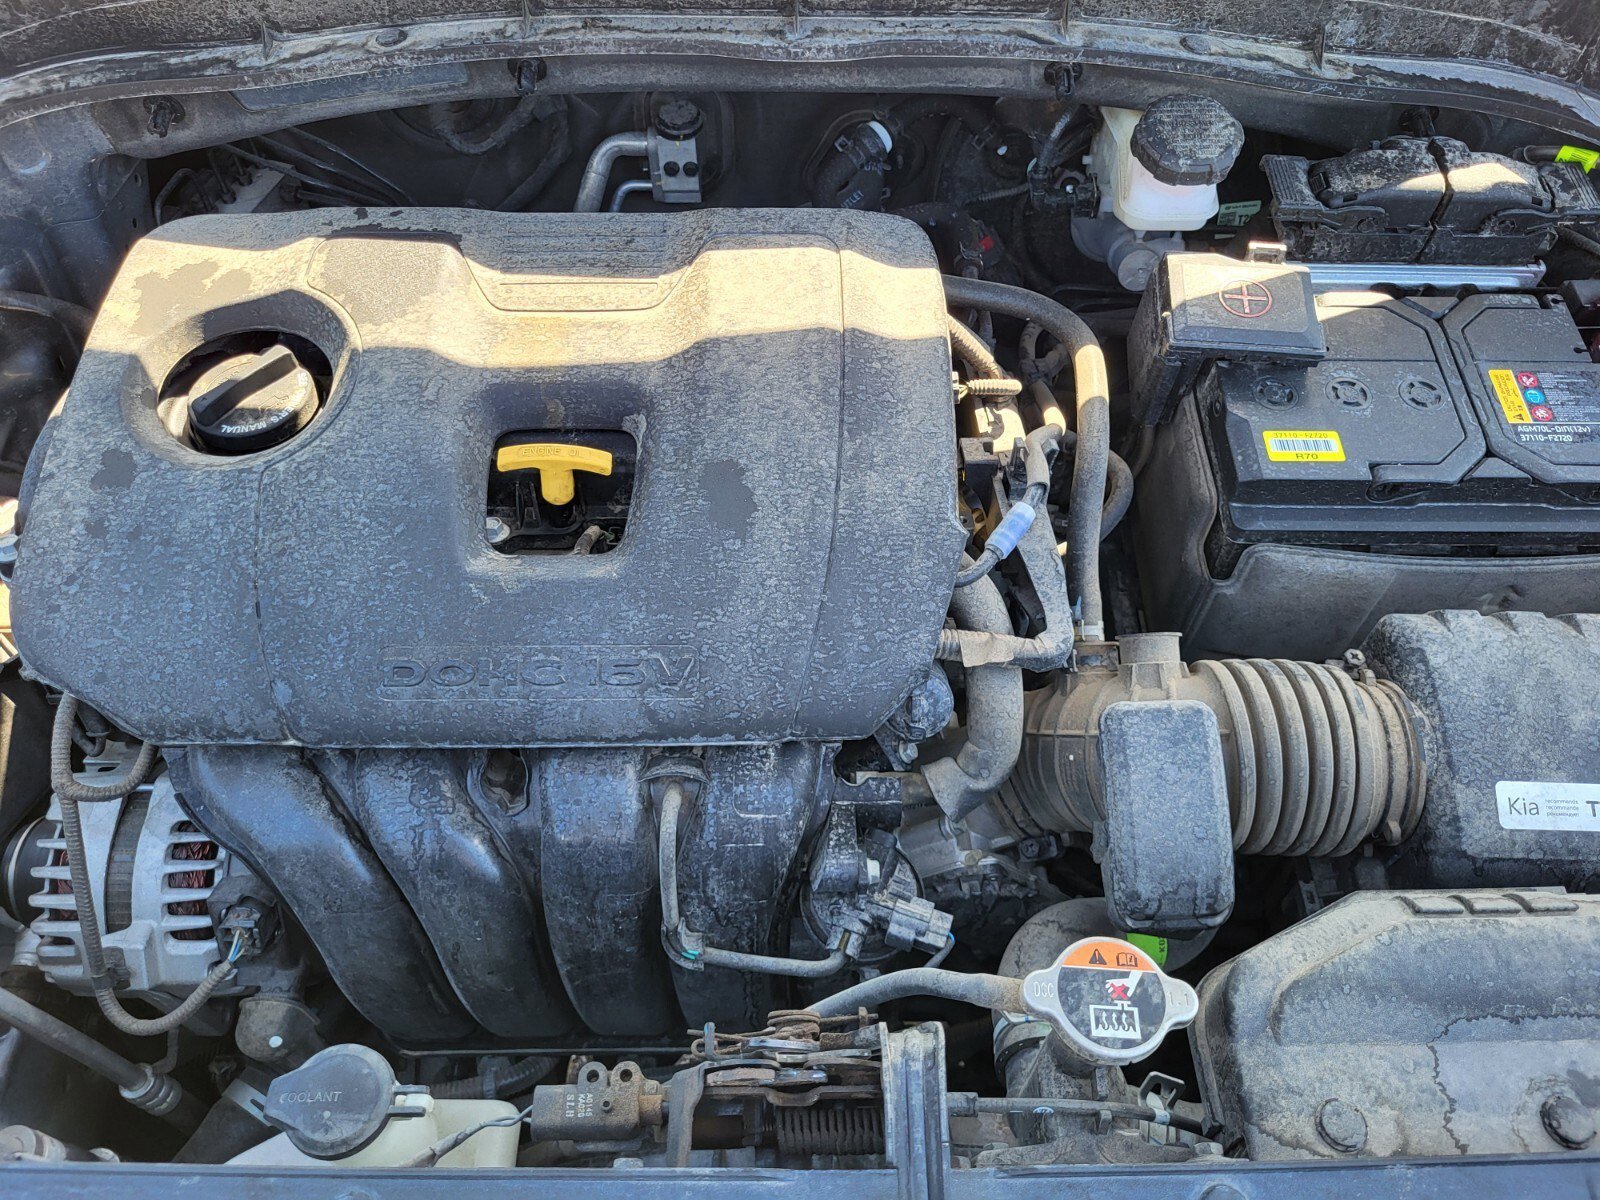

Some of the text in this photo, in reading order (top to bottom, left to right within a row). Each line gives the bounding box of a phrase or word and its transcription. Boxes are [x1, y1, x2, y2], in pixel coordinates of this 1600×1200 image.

[221, 422, 268, 434] MANUAL
[1520, 434, 1573, 442] 37110-F2720
[521, 446, 562, 457] ENGINE
[382, 655, 695, 688] DOHC 16V
[1507, 796, 1540, 816] Kia
[279, 1091, 343, 1104] COOLANT
